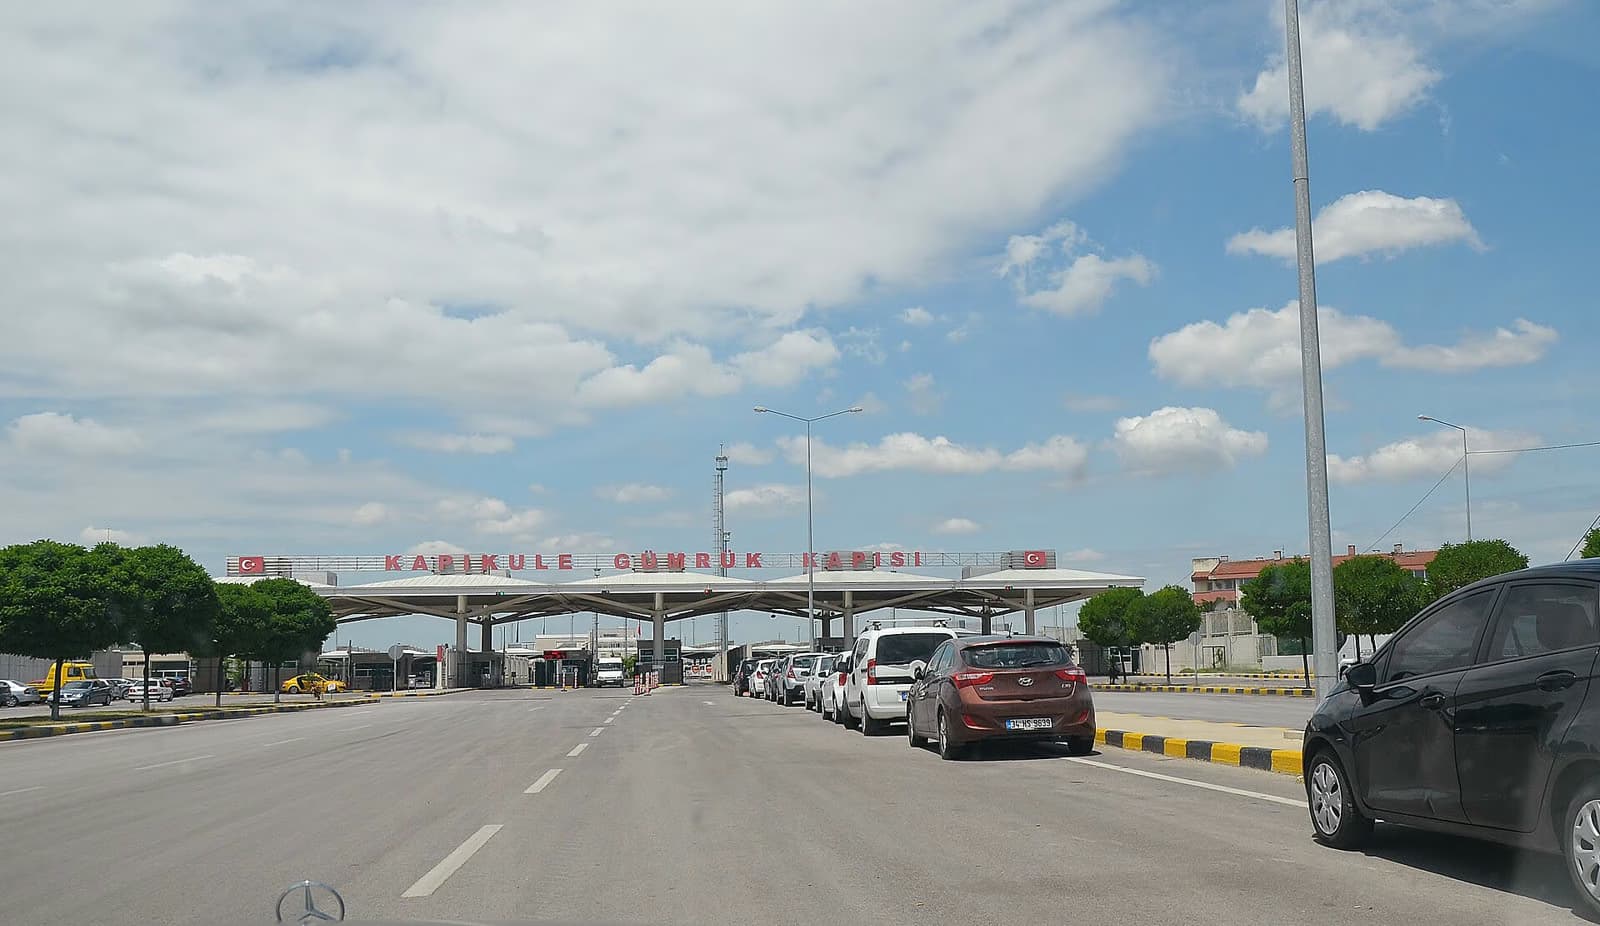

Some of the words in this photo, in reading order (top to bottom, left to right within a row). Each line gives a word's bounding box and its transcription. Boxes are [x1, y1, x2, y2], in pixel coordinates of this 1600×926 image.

[385, 554, 573, 571] KAPIKULE
[613, 550, 762, 569] GÜMRÜK
[802, 552, 920, 568] KAPISI
[1010, 720, 1019, 729] 34
